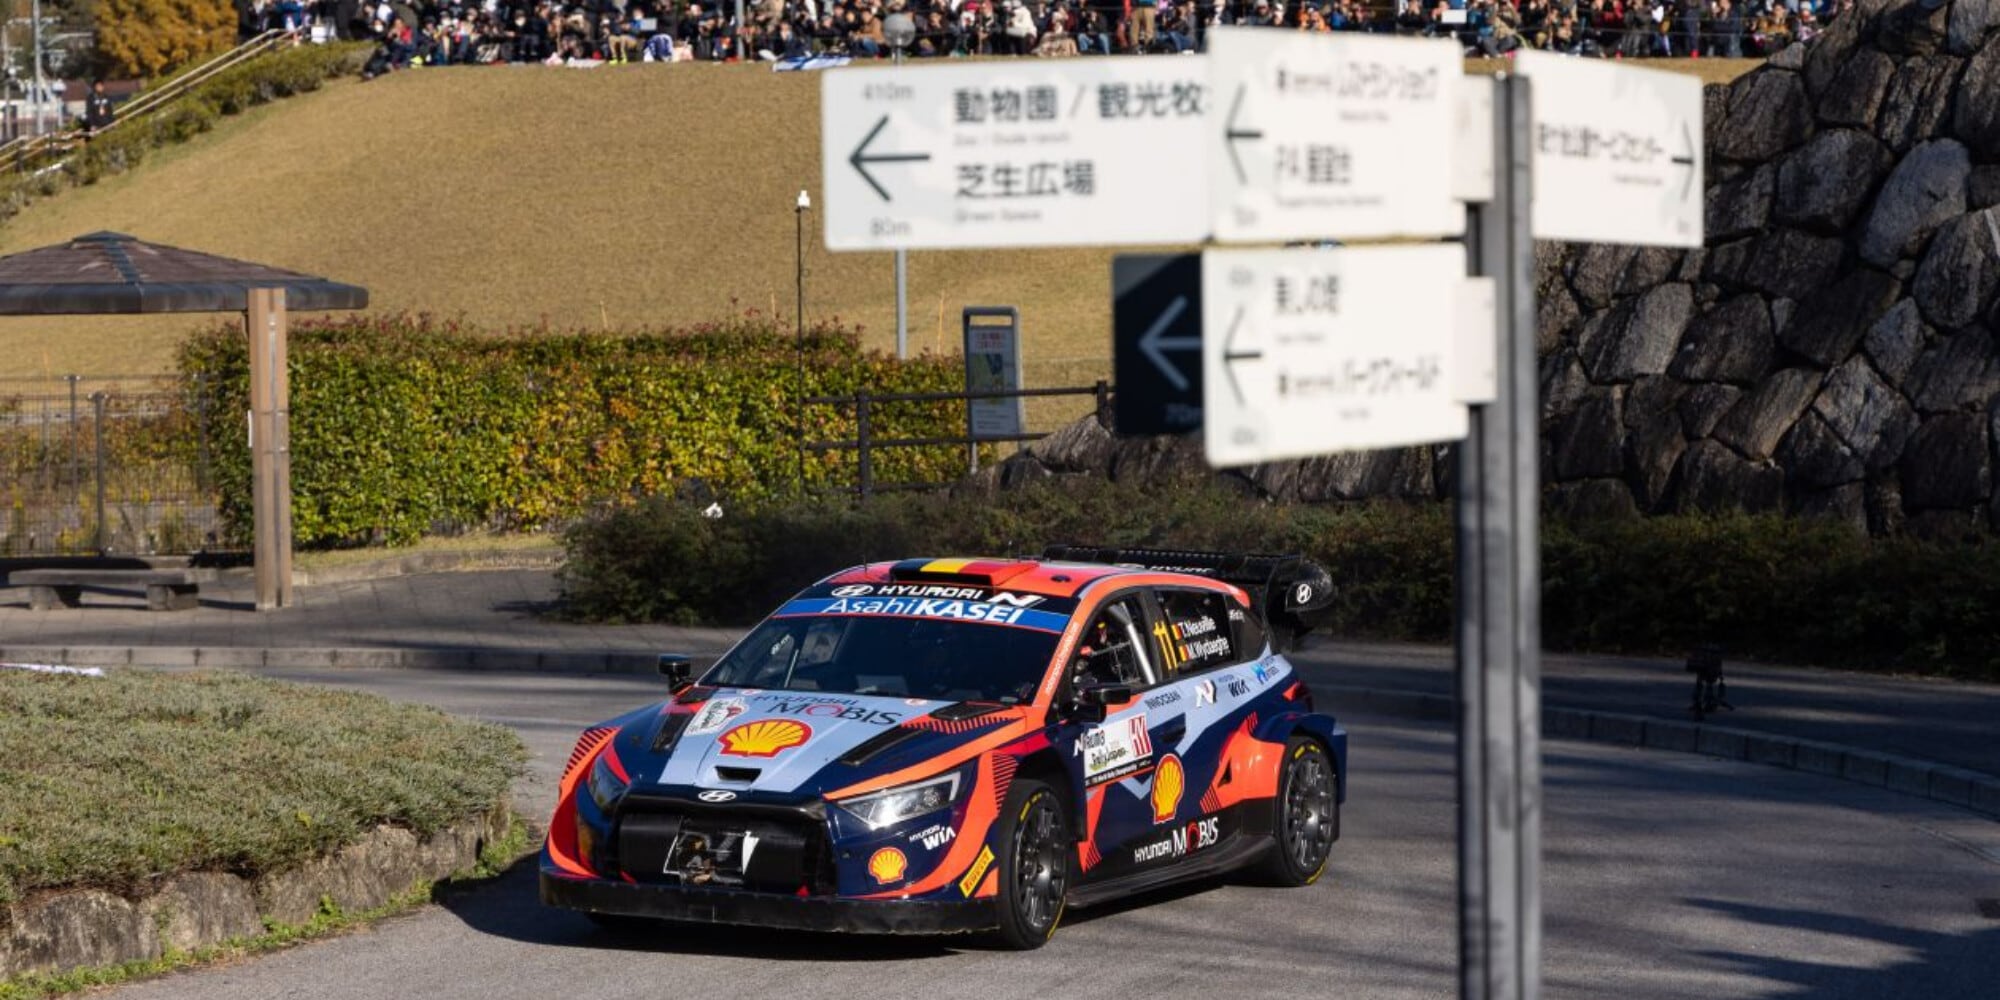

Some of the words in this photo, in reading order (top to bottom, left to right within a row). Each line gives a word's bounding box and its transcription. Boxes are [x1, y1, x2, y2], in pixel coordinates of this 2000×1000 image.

[862, 82, 914, 102] 410m
[953, 86, 1058, 123] 動物園
[1069, 87, 1087, 117] /
[1098, 82, 1209, 119] 観光牧
[956, 160, 1096, 200] 芝生広場
[870, 218, 911, 237] 80m
[877, 585, 983, 600] HYUNDAI
[822, 596, 1025, 625] AsahiKASEI
[1153, 621, 1178, 670] 11
[753, 694, 860, 706] HYUNDAI
[767, 702, 903, 726] MOBIS
[922, 826, 956, 850] WIA
[1134, 840, 1172, 863] HYUNDAI
[1172, 817, 1219, 857] MOBIS
